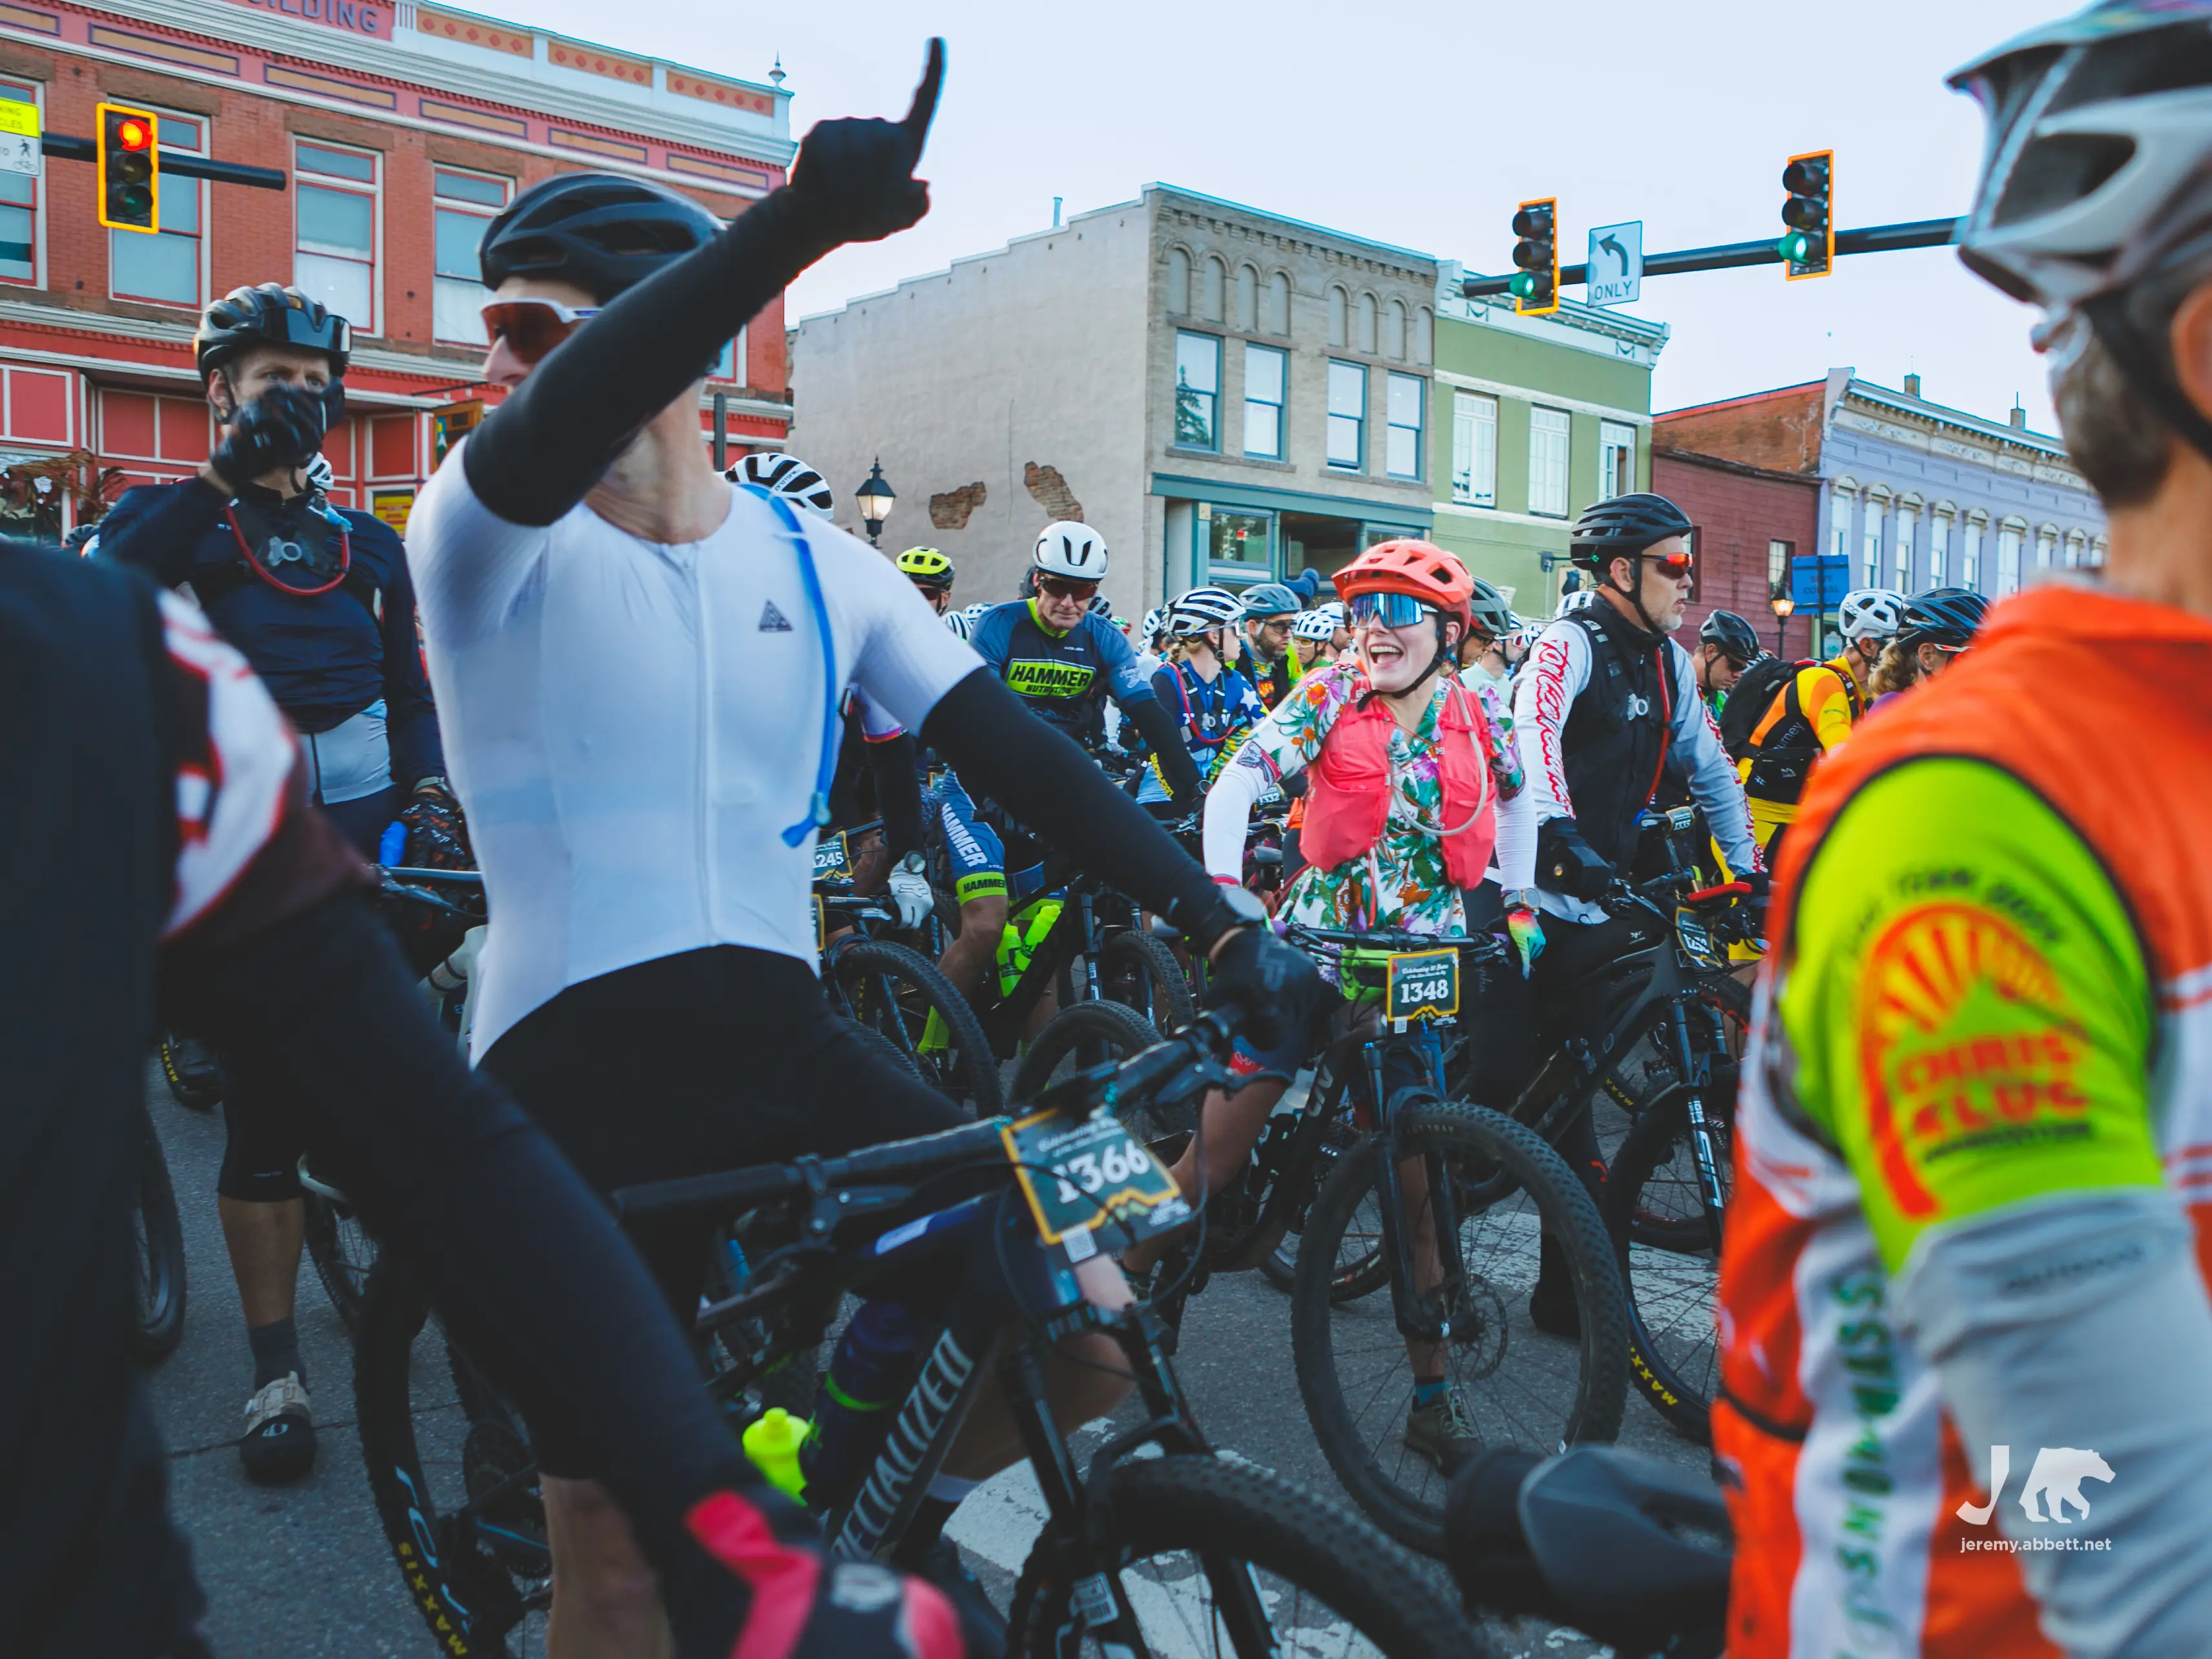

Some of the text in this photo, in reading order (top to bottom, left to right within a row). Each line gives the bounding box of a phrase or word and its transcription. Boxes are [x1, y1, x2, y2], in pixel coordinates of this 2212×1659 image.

[247, 0, 378, 32] LDING
[0, 107, 21, 116] ING
[1594, 280, 1633, 300] ONLY
[1011, 665, 1090, 687] HAMMER
[943, 802, 988, 867] HAMMER
[963, 879, 1006, 893] HAMME
[1401, 979, 1449, 1003] 1348
[1053, 1139, 1151, 1204] 1366
[831, 1328, 974, 1562] PECIALIZED
